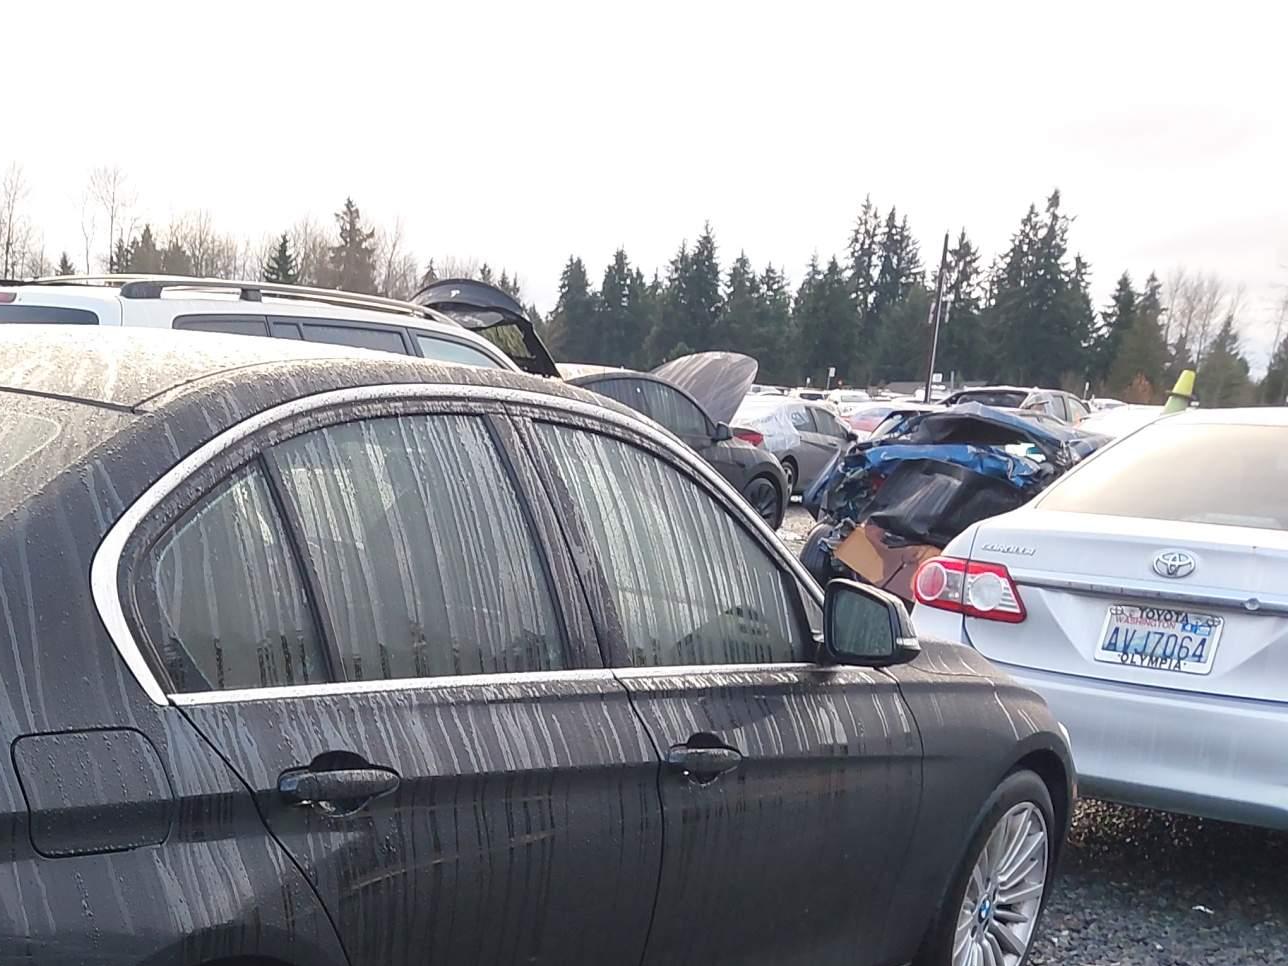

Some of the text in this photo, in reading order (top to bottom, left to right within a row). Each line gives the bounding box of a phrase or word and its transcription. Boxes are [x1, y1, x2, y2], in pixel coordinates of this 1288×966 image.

[1139, 606, 1189, 624] TOYOTA
[1105, 626, 1208, 663] AVJ7064
[1120, 652, 1182, 671] OLYMPIA
